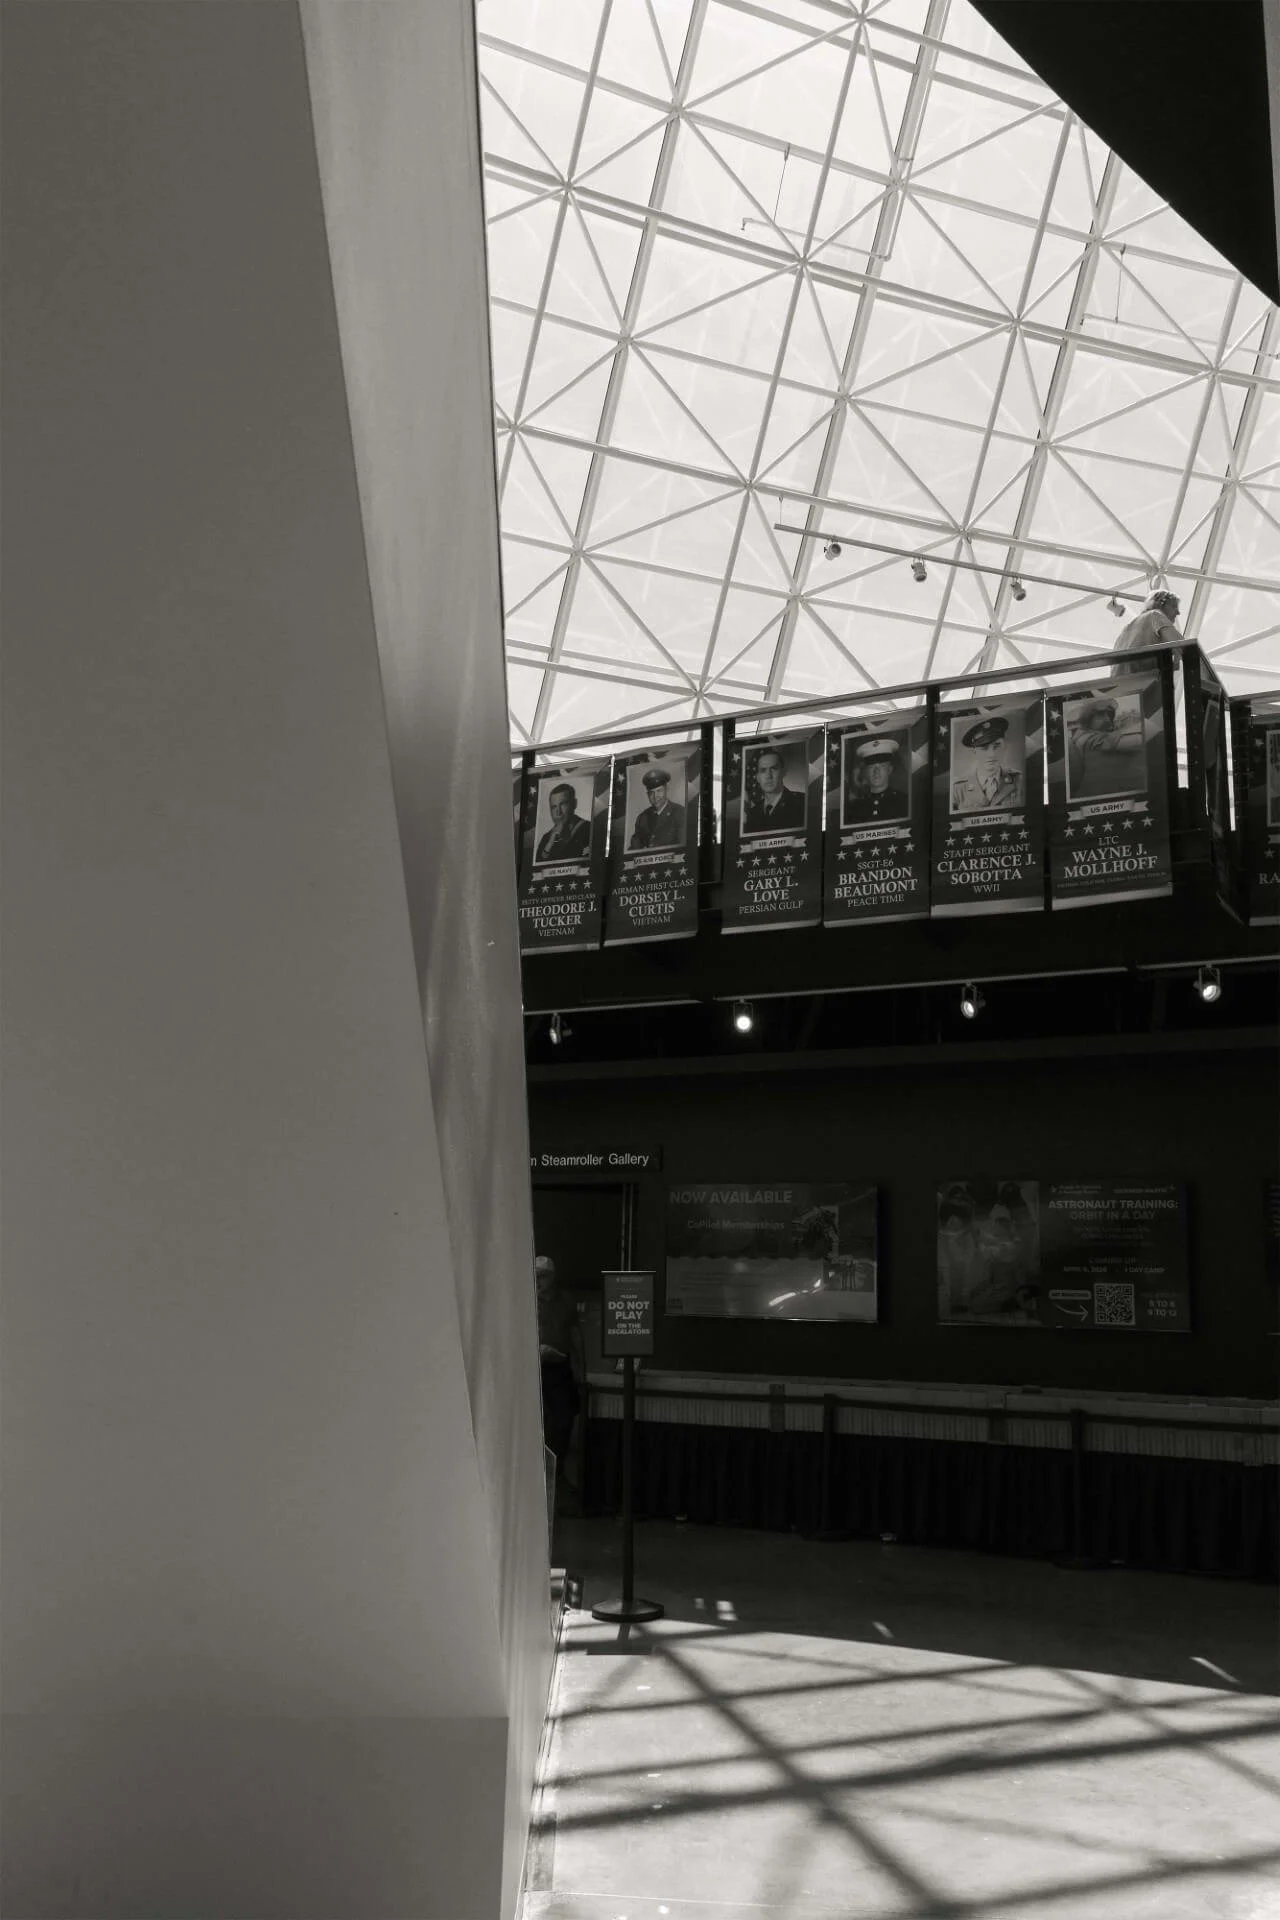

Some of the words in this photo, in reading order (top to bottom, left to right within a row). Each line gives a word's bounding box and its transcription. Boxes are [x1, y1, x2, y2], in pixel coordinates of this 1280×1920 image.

[1090, 806, 1101, 814] US
[1102, 803, 1125, 813] ARMY
[982, 816, 1003, 824] ARMY
[865, 829, 897, 839] MARINES
[1098, 836, 1120, 846] LTC
[769, 839, 787, 847] ARMY
[943, 847, 975, 859] STAFF
[975, 843, 1031, 857] SERGEANT
[1072, 846, 1133, 865] WAYNE
[1135, 843, 1148, 857] J.
[857, 859, 894, 871] SSGT-E6
[937, 854, 1022, 874] CLARENCE
[1025, 853, 1036, 867] J.
[1063, 856, 1158, 879] MOLLHOFF
[747, 866, 796, 878] SERGEANT
[839, 866, 913, 885] BRANDON
[951, 868, 1022, 886] SOBOTTA
[611, 884, 645, 896] AIRMAN
[646, 881, 668, 893] FIRST
[669, 878, 695, 889] CLASS
[743, 876, 785, 892] GARY
[786, 875, 799, 887] L.
[834, 878, 918, 899] BEAUMONT
[973, 883, 1000, 895] WWII
[619, 892, 671, 907] DORSEY
[673, 890, 685, 900] L.
[753, 889, 790, 903] LOVE
[847, 895, 878, 908] PEACE
[879, 893, 905, 904] TIME
[519, 901, 586, 918] THEODORE
[588, 901, 597, 912] J.
[628, 902, 676, 918] CURTIS
[738, 901, 779, 915] PERSIAN
[779, 900, 804, 911] GULF
[533, 914, 582, 928] TUCKER
[632, 915, 671, 926] VIETNAM
[538, 927, 575, 937] VIETNAM
[541, 1154, 604, 1167] Steamroller
[608, 1153, 650, 1167] Gallery
[669, 1191, 706, 1204] NOW
[709, 1190, 793, 1204] AVAILABLE
[1048, 1199, 1117, 1209] ASTRONAUT
[1120, 1199, 1179, 1209] TRAINING:
[1070, 1211, 1103, 1221] ORBIT
[1107, 1211, 1119, 1221] IN
[1121, 1211, 1130, 1221] A
[1133, 1211, 1156, 1221] DAY
[608, 1301, 625, 1310] DO
[627, 1301, 650, 1310] NOT
[615, 1311, 643, 1320] PLAY
